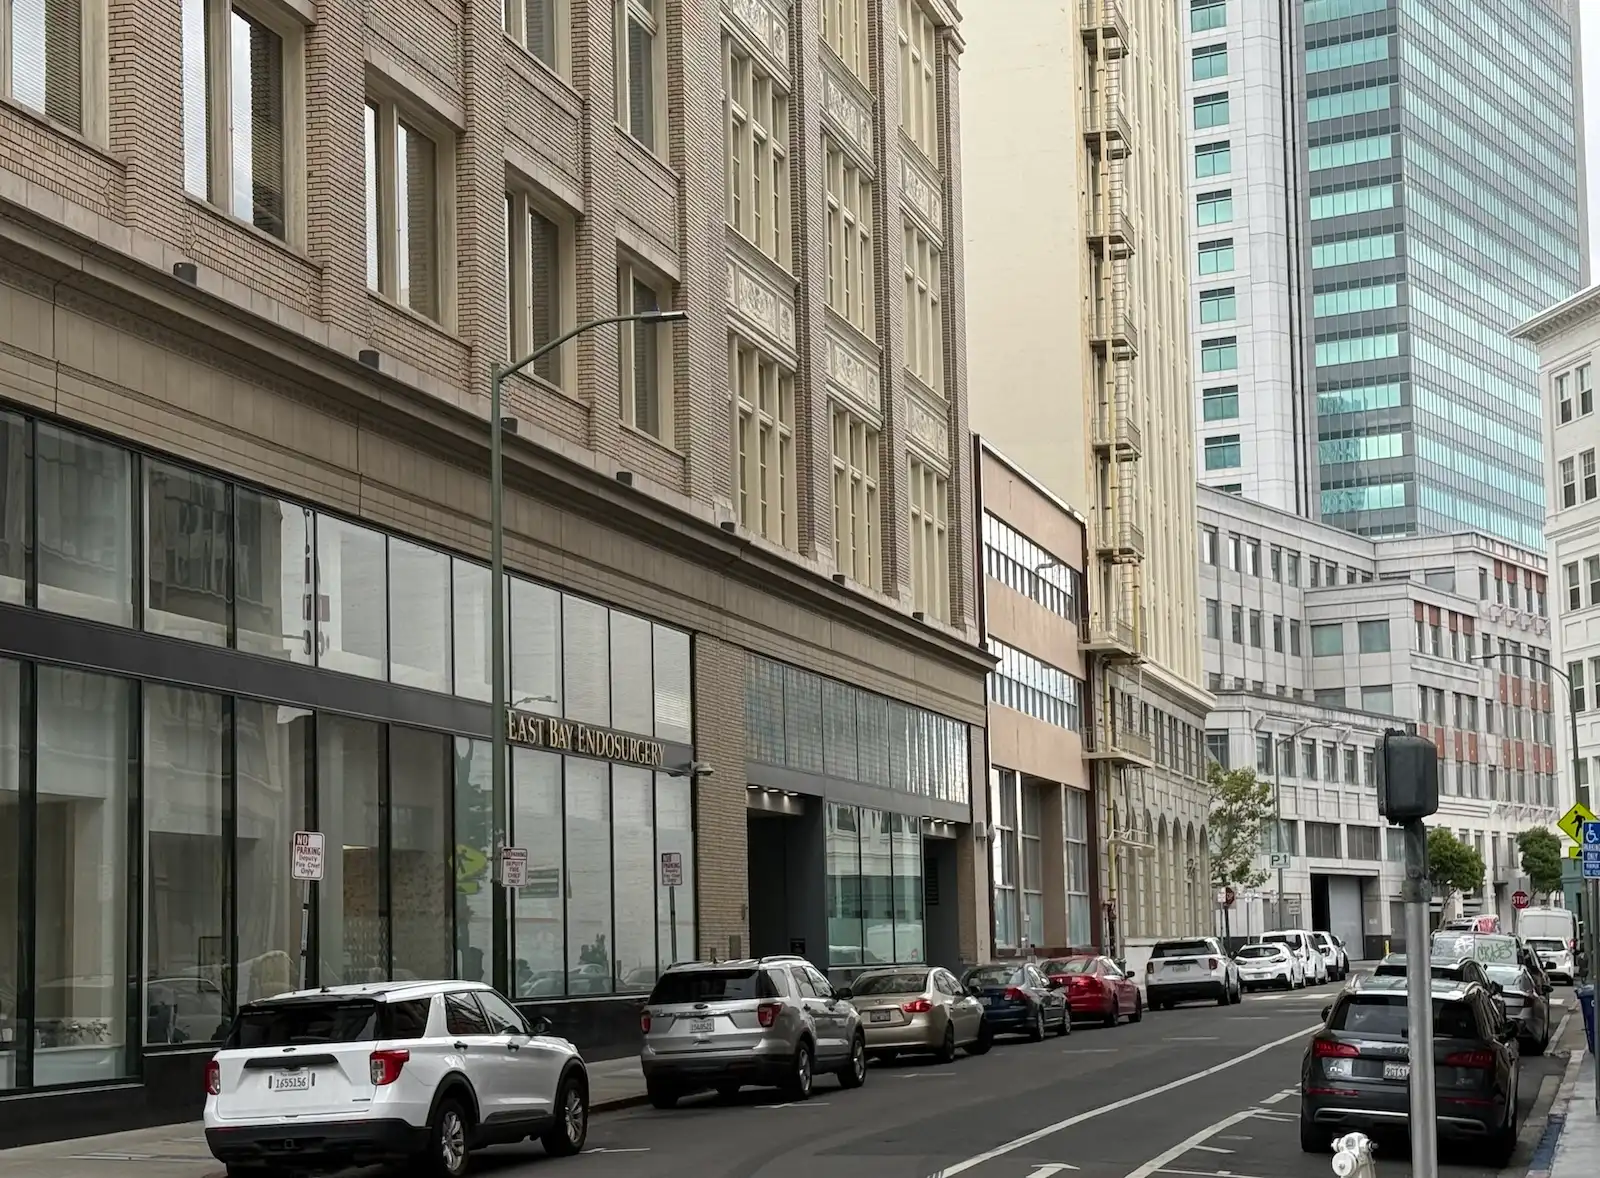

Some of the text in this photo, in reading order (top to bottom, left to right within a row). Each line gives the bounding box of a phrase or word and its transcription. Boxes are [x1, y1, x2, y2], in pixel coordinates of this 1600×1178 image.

[507, 709, 666, 767] EAST BAY ENDOSURGERY
[296, 834, 308, 845] NO
[296, 846, 321, 856] PARKING
[1271, 855, 1280, 866] P
[1512, 895, 1529, 905] STOP
[276, 1077, 307, 1089] 1655156
